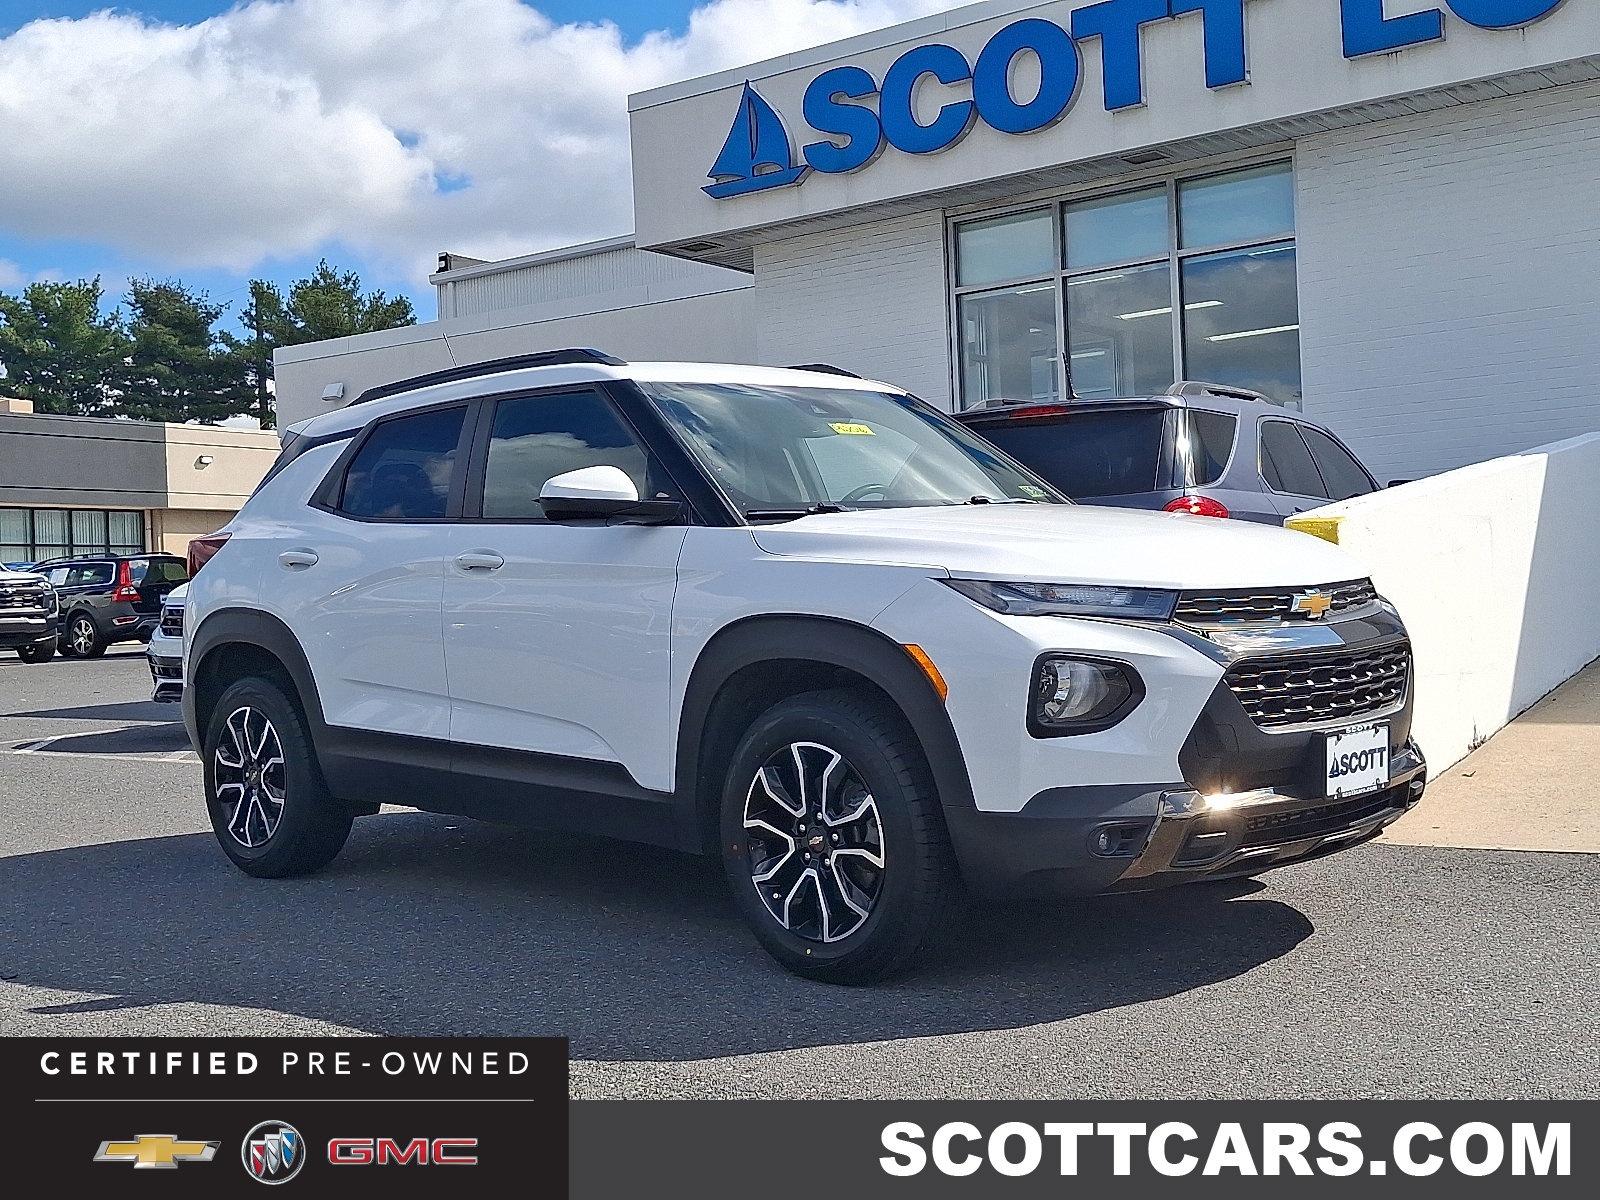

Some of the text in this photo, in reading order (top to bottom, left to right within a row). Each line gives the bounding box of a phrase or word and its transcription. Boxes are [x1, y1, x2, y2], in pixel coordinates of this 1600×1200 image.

[803, 0, 1567, 173] SCOTT L
[1340, 746, 1387, 776] SCOTT
